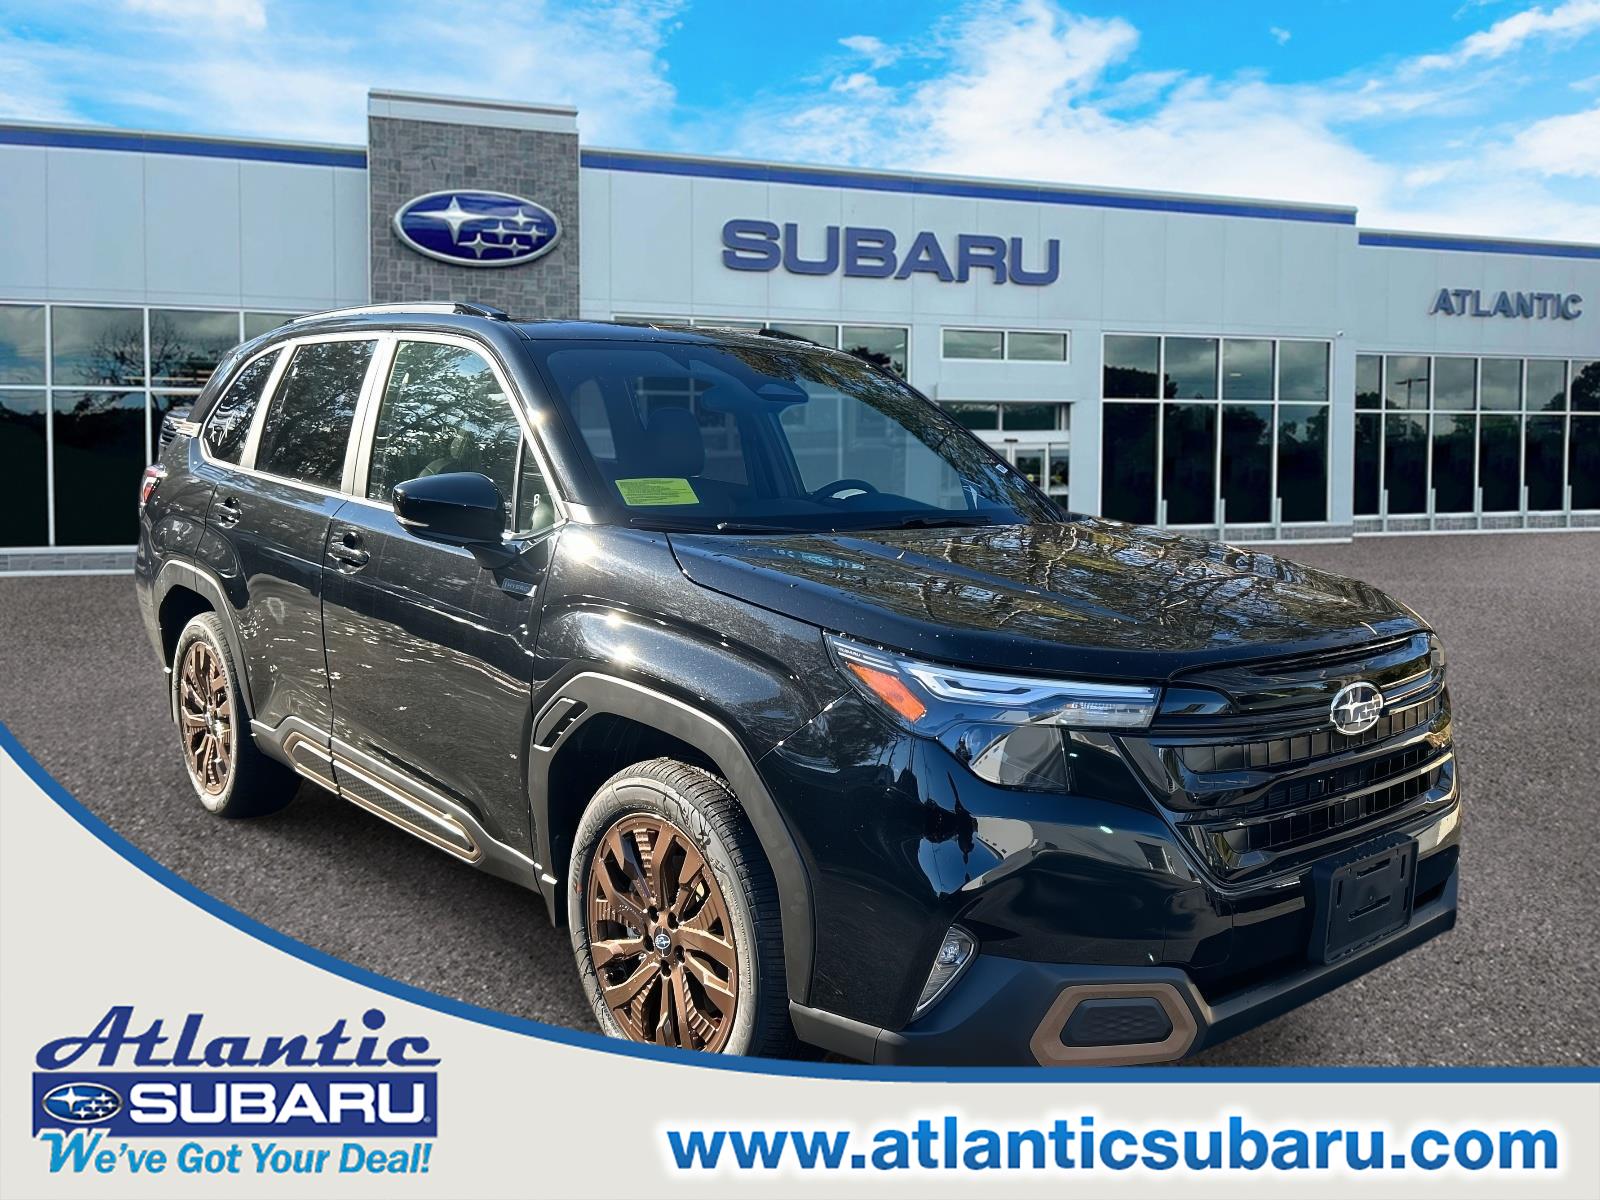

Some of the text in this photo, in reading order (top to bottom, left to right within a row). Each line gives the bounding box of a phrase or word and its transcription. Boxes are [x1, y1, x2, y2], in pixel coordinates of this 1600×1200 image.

[722, 219, 1060, 285] SUBARU
[1430, 288, 1582, 320] ATLANTIC
[838, 647, 861, 657] SUBARU
